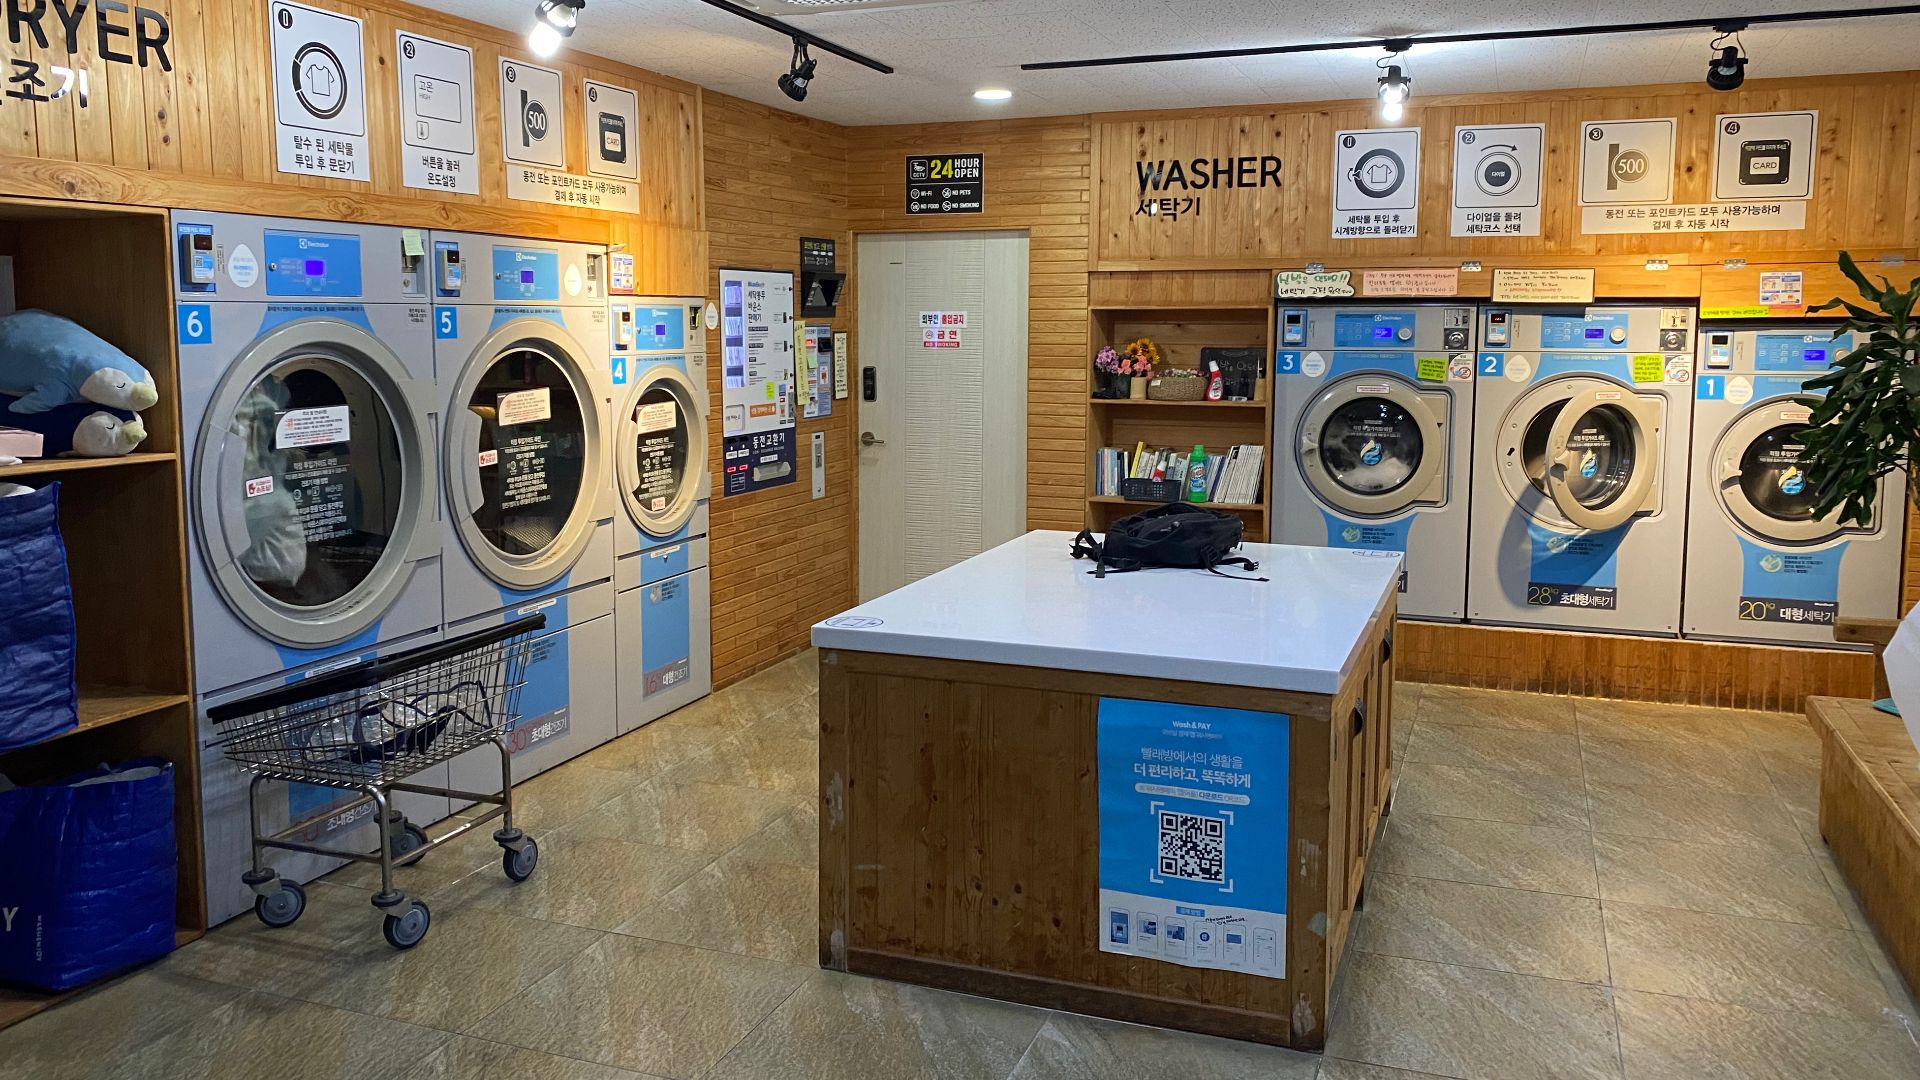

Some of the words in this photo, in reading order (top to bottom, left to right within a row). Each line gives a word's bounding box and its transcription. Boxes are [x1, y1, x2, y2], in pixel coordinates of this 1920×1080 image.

[0, 0, 172, 72] RYER
[406, 43, 414, 56] 2
[507, 68, 514, 81] 3
[0, 59, 88, 108] 조기
[419, 80, 434, 92] 고온
[528, 111, 546, 130] 500
[1727, 123, 1737, 133] 4
[1465, 133, 1473, 143] 2
[1592, 129, 1601, 139] 3
[294, 136, 312, 151] 탈수
[315, 138, 325, 152] 된
[328, 140, 354, 156] 세탁물
[295, 154, 313, 168] 투입
[316, 155, 326, 170] 후
[329, 157, 355, 174] 문닫기
[422, 155, 443, 170] 버튼을
[446, 159, 460, 172] 눌러
[930, 159, 953, 178] 24
[954, 158, 980, 168] HOUR
[1618, 159, 1645, 174] 500
[1753, 160, 1777, 169] CARD
[428, 173, 456, 187] 온도설정
[954, 168, 979, 178] OPEN
[1136, 156, 1282, 192] WASHER
[523, 171, 536, 183] 동전
[537, 173, 549, 185] 또는
[552, 175, 580, 190] 포인트카드
[582, 179, 593, 191] 모두
[595, 180, 627, 196] 사용가능하며
[554, 190, 567, 202] 결제
[568, 192, 575, 203] 후
[576, 193, 587, 204] 자동
[589, 194, 600, 206] 시작
[1135, 196, 1200, 222] 세탁기
[1605, 208, 1624, 219] 동전
[1627, 208, 1646, 219] 또는
[1650, 207, 1696, 218] 포인트카드
[1699, 206, 1718, 217] 모두
[1722, 205, 1781, 216] 사용가능하며
[1347, 214, 1371, 224] 세탁물
[1374, 214, 1390, 224] 투입
[1392, 214, 1400, 223] 후
[1467, 213, 1501, 222] 다이얼을
[1504, 212, 1521, 222] 돌려
[1653, 219, 1671, 230] 결제
[1675, 219, 1684, 229] 후
[1687, 219, 1706, 229] 자동
[1710, 218, 1730, 229] 시작
[1334, 226, 1381, 235] 시계방향으로
[1384, 225, 1415, 234] 돌려닫기
[1466, 224, 1500, 233] 세탁코스
[1504, 223, 1521, 233] 선택
[187, 311, 203, 337] 6
[441, 312, 452, 333] 5
[922, 314, 939, 325] 외부인
[941, 314, 964, 325] 출입금지
[1283, 355, 1294, 370] 3
[1484, 356, 1497, 373] 2
[614, 363, 623, 380] 4
[1706, 379, 1715, 396] 1
[753, 432, 785, 449] 동전교환기
[1560, 592, 1613, 607] 초대형세탁기
[1780, 607, 1835, 622] 대형세탁기
[531, 716, 567, 743] 초대형건조기
[1141, 747, 1207, 764] 빨래방에서의
[1209, 754, 1243, 769] 생활을
[1134, 763, 1146, 775] 더
[1149, 764, 1199, 782] 편리하고,
[1202, 769, 1250, 788] 똑똑하게
